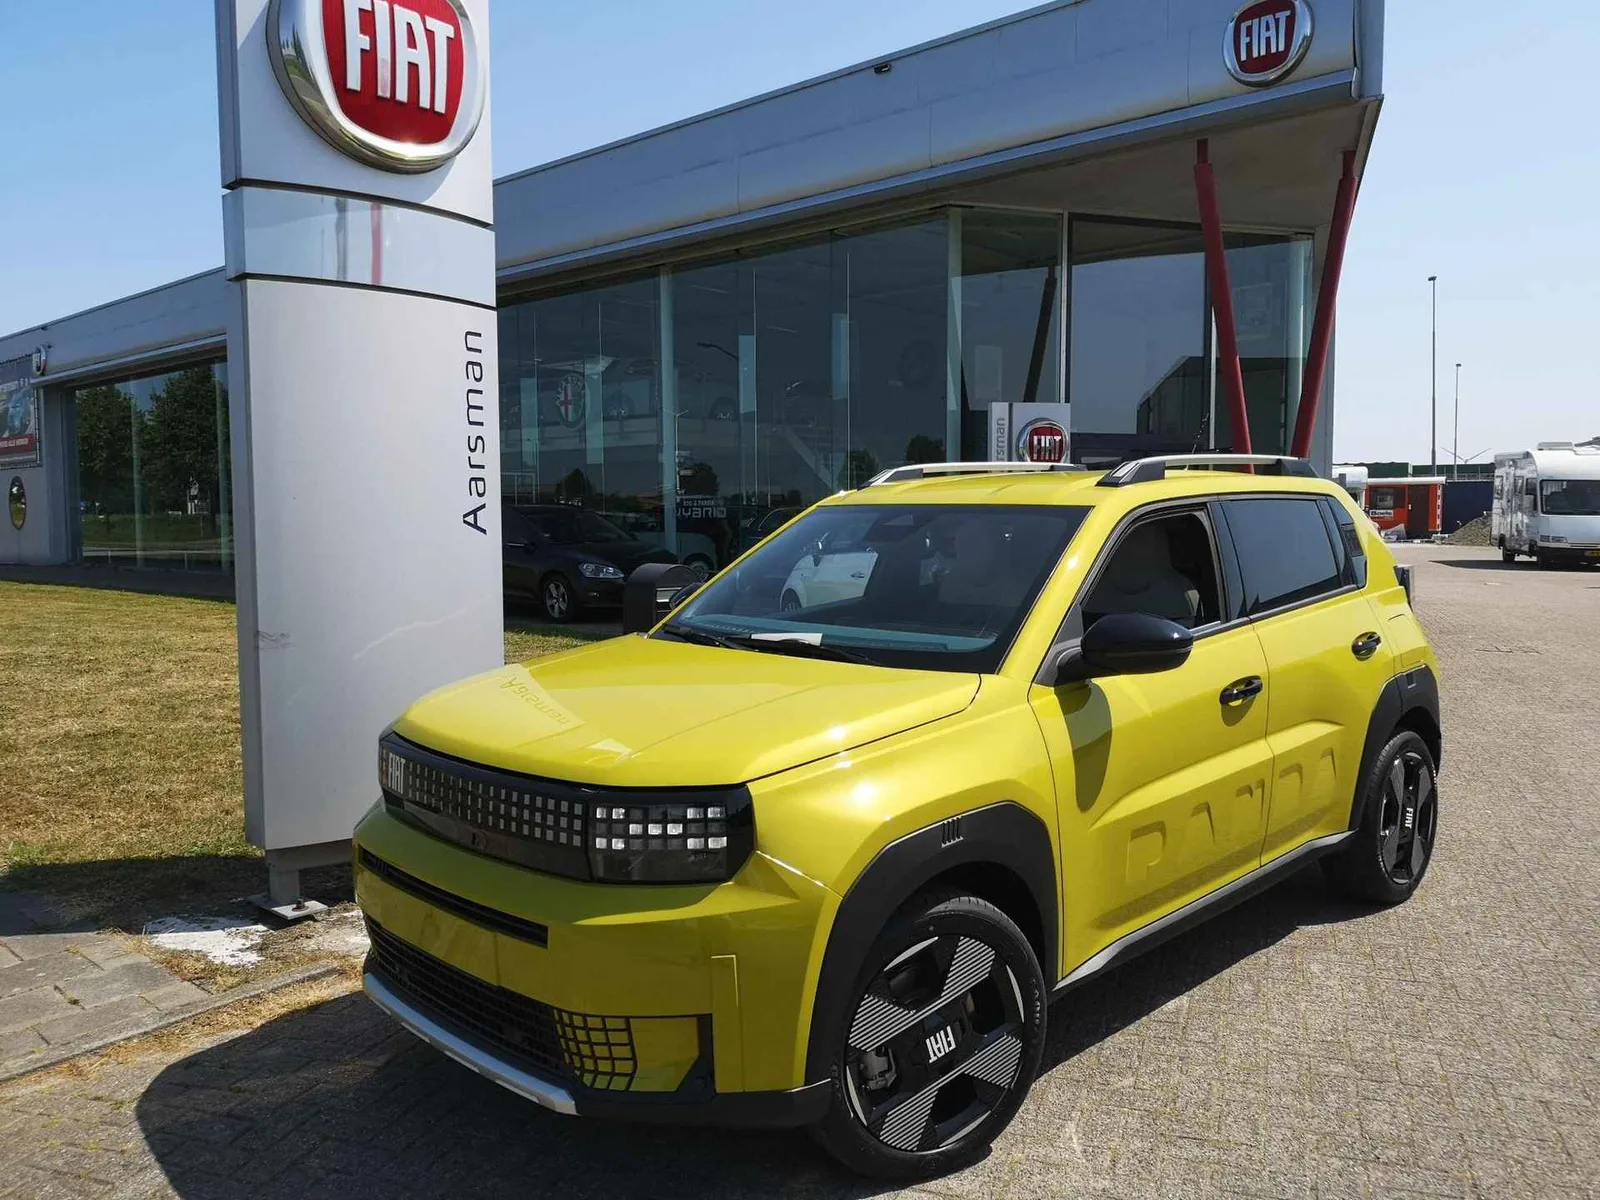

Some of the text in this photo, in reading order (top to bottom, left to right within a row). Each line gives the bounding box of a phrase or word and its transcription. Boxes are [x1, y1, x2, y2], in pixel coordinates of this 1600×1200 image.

[343, 0, 455, 114] FIAT
[1240, 11, 1291, 61] FIAT
[462, 330, 487, 535] Aarsman
[995, 417, 1006, 462] rsman
[1033, 435, 1062, 460] FIAT
[388, 752, 406, 794] FIAT
[1125, 747, 1338, 884] PANDA
[1404, 807, 1414, 829] FIAT
[925, 1025, 956, 1064] FIAT
